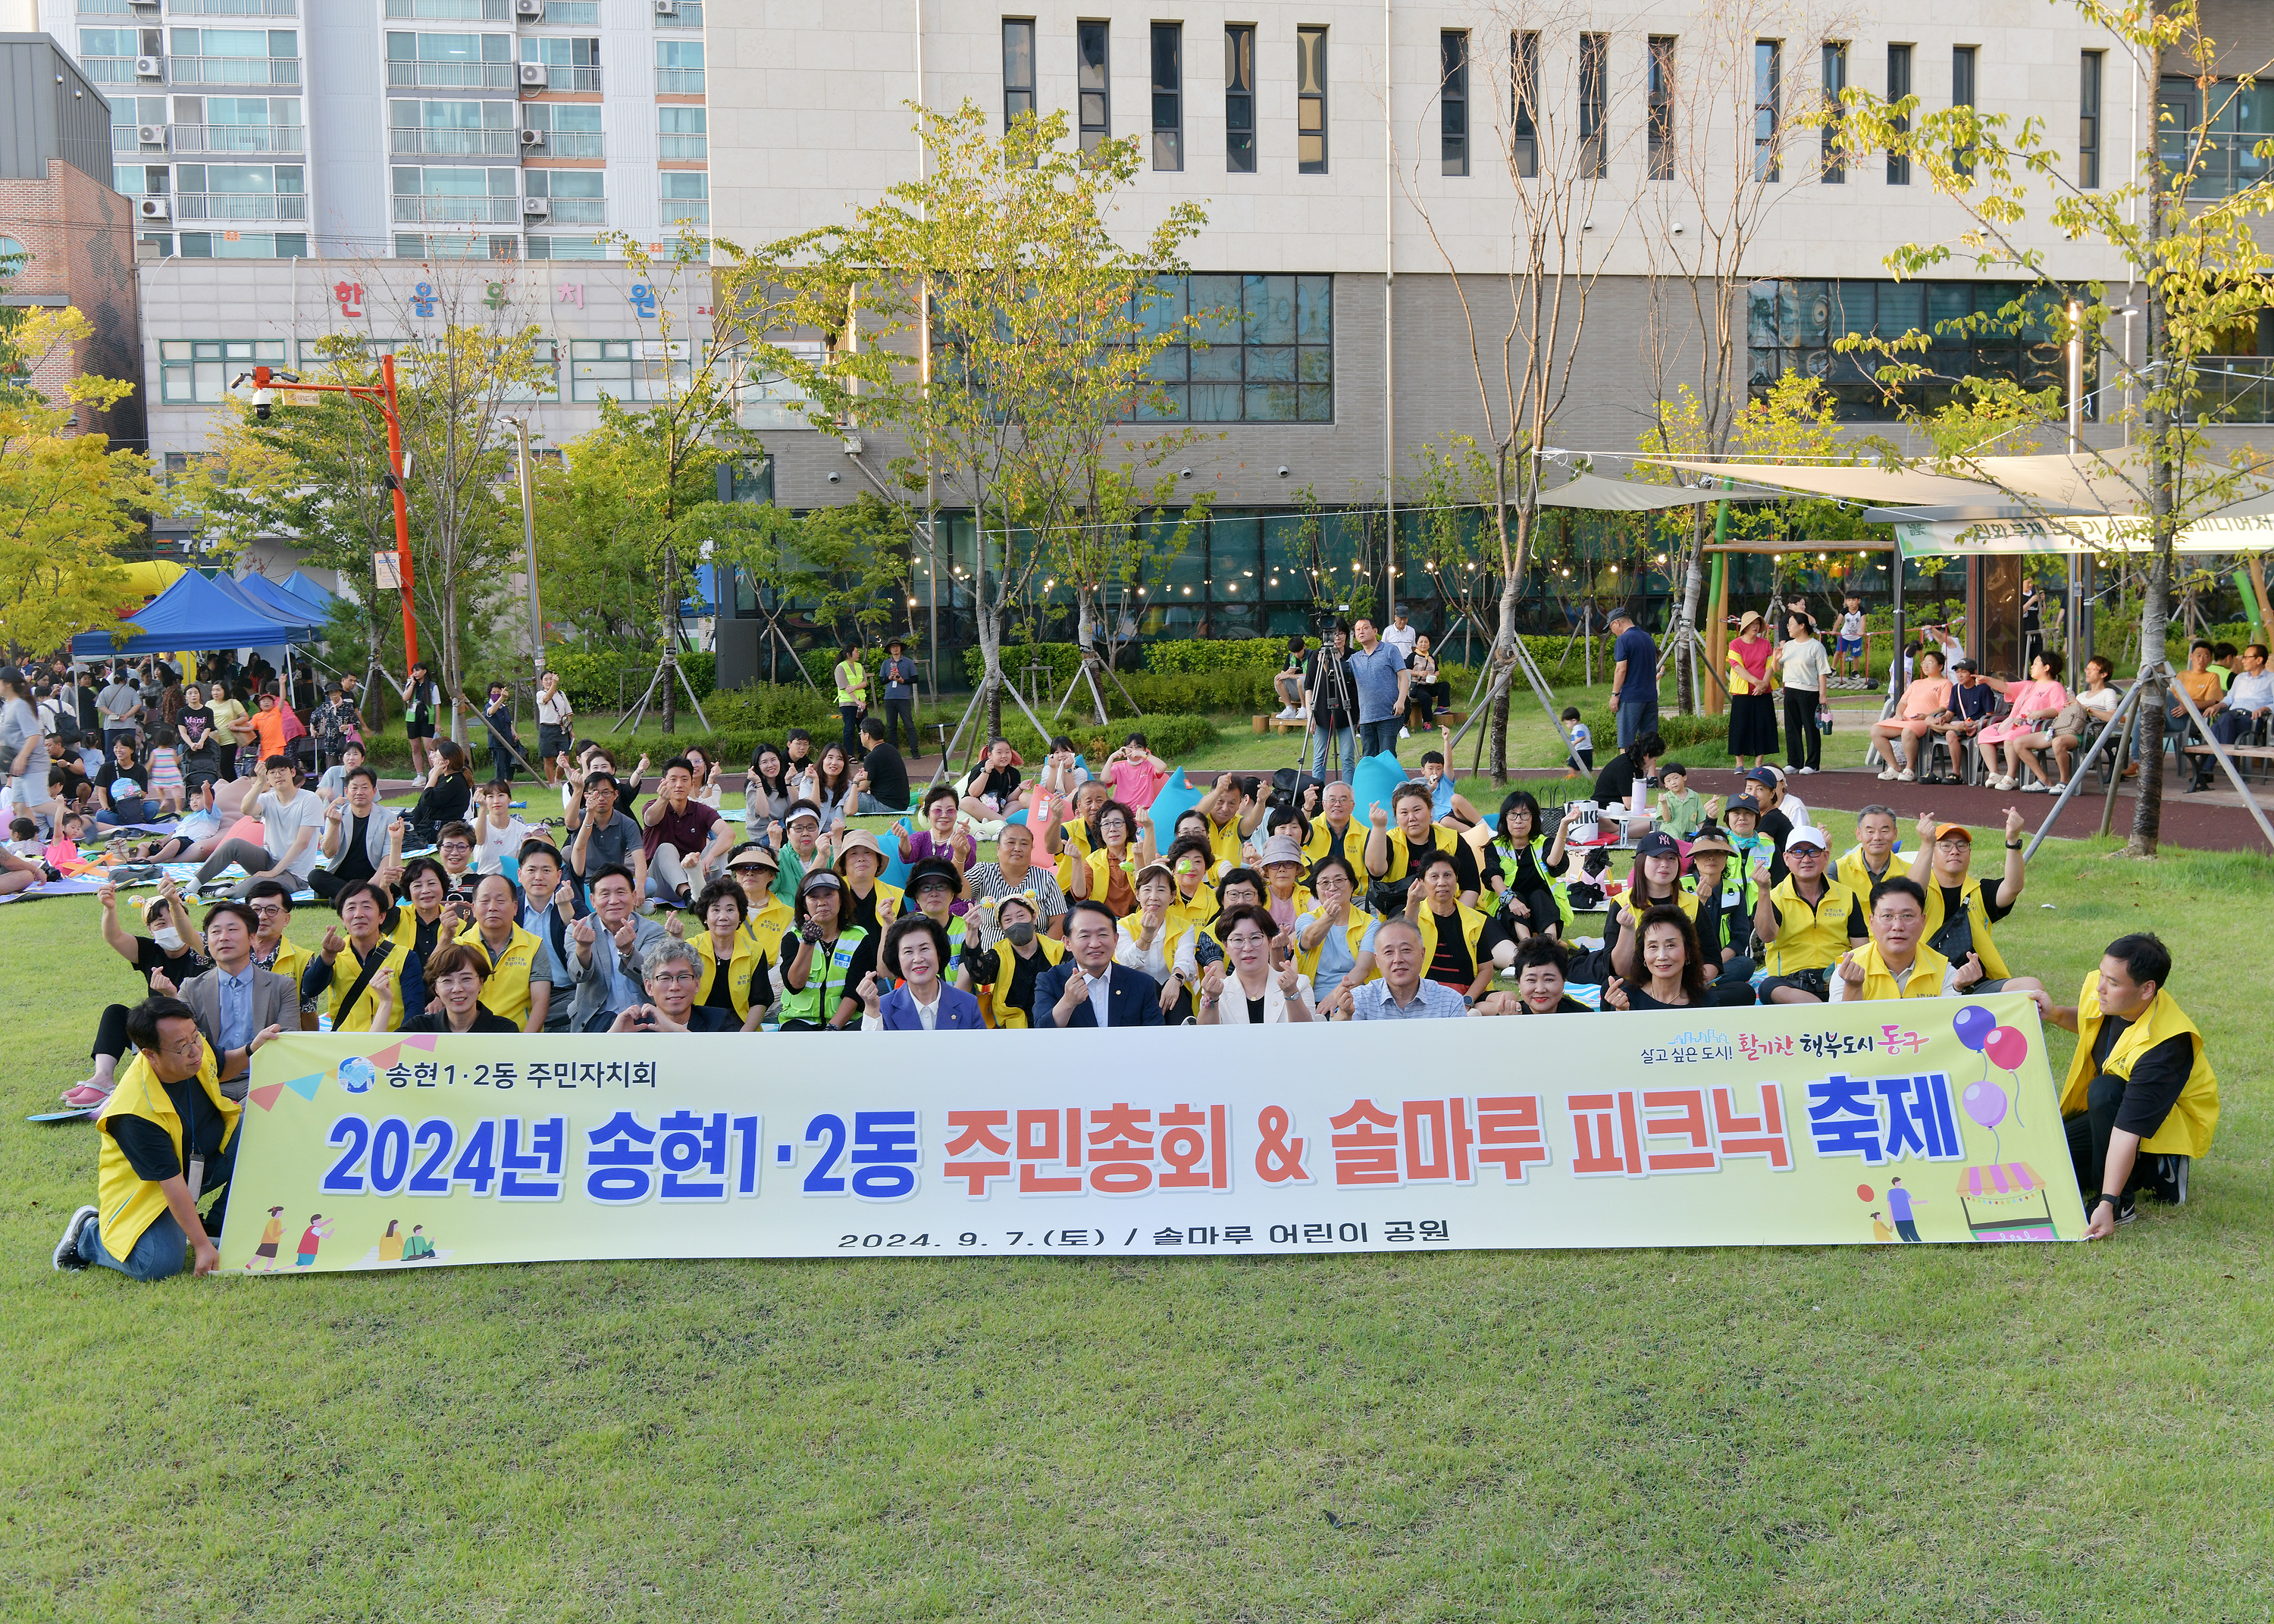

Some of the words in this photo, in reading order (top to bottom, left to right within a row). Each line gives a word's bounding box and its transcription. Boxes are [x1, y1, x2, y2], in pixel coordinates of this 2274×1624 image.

[1659, 834, 1671, 846] NY
[1641, 1049, 1668, 1064] 살고
[1671, 1047, 1698, 1062] 싶은
[1702, 1046, 1733, 1061] 도시!
[1738, 1032, 1795, 1061] 활기찬
[1878, 1024, 1931, 1056] 동구
[527, 1061, 656, 1089] 주민자치회
[323, 1116, 564, 1197] 2024년
[943, 1102, 1228, 1196] 주민총회
[1254, 1104, 1308, 1184] &
[1328, 1095, 1546, 1186] 솔마루
[1568, 1084, 1789, 1175] 피크닉
[1807, 1074, 1961, 1162] 축제
[838, 1233, 941, 1248] 2024.
[958, 1231, 988, 1247] 9.
[1152, 1225, 1254, 1246] 솔마루
[1269, 1222, 1368, 1244] 어린이
[1383, 1219, 1450, 1242] 공원
